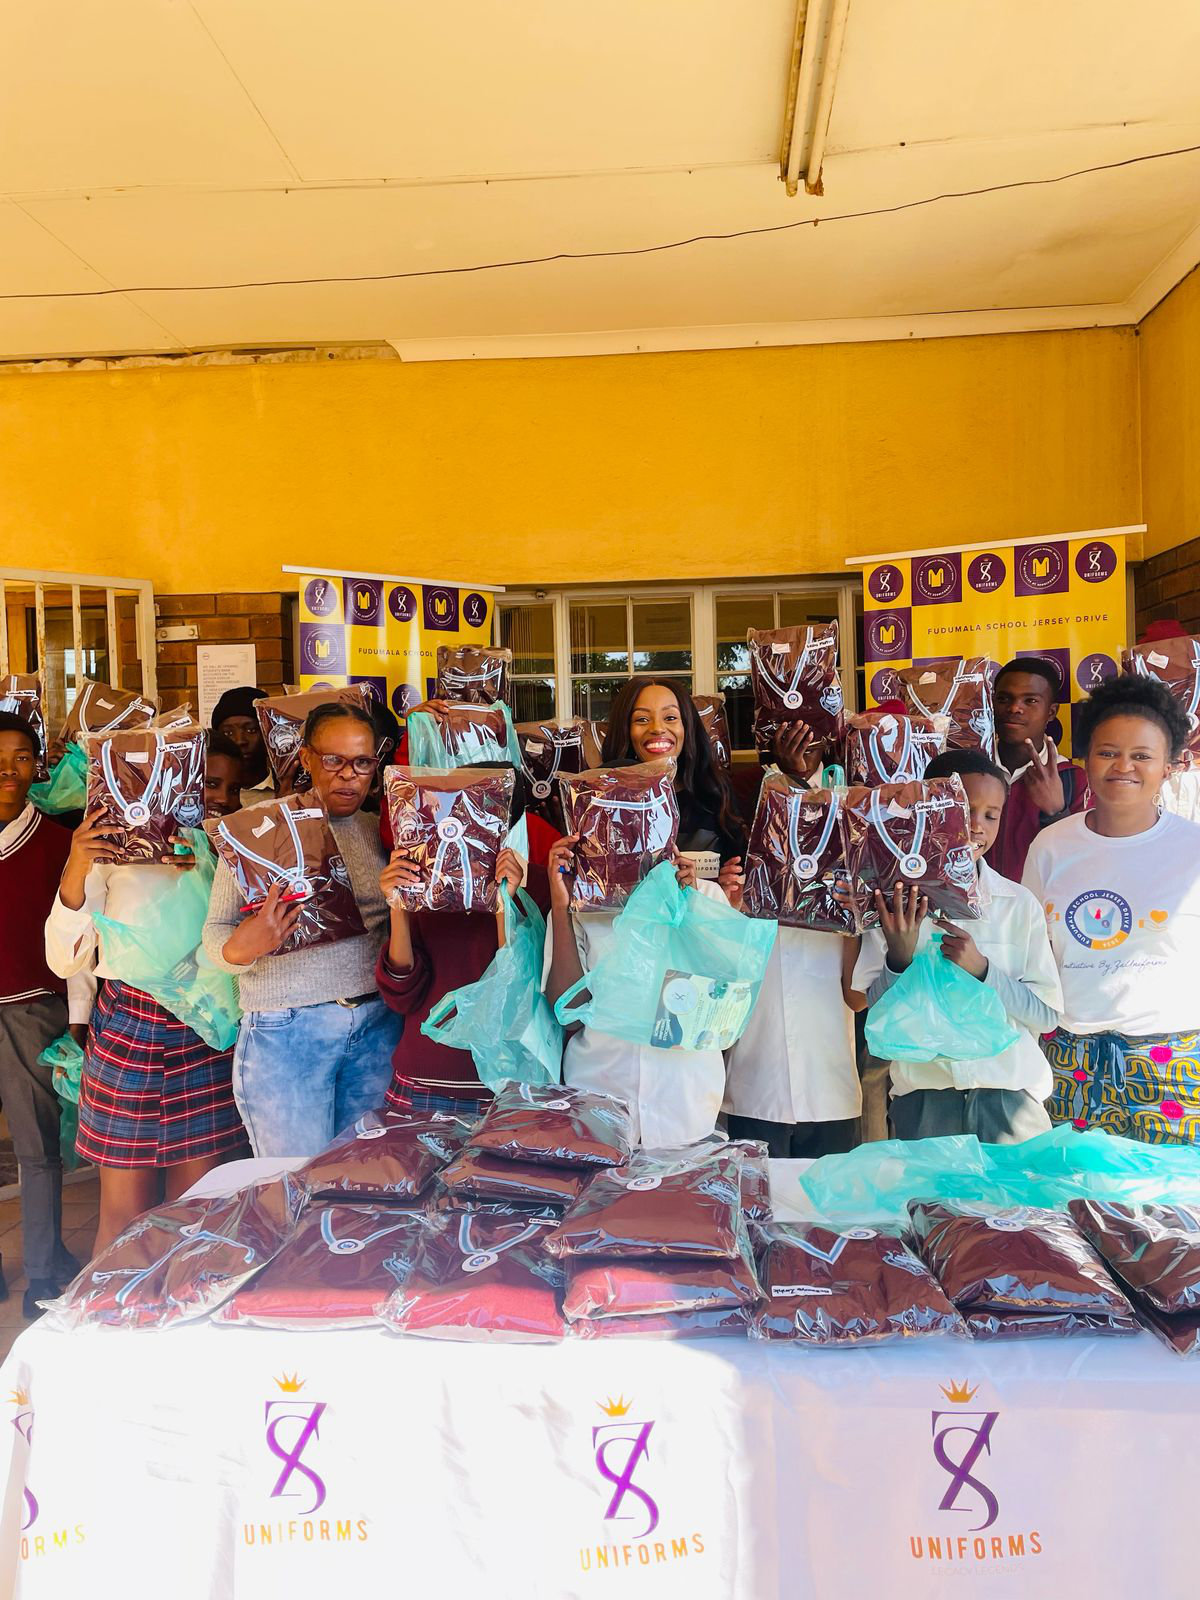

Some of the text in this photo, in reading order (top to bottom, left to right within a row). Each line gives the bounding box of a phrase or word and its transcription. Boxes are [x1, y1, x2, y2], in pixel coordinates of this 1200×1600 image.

[927, 613, 1109, 636] FUDUMALA SCHOOL JERSEY DRIVE
[358, 647, 400, 656] FUDUMALA
[1067, 891, 1130, 945] FUDUMALA SCHOOL JERSEY DRIVE
[1098, 959, 1111, 977] By
[20, 1522, 86, 1561] ORMS
[244, 1518, 369, 1546] UNIFORMS
[909, 1530, 1043, 1561] UNIFORMS
[579, 1532, 705, 1572] UNIFORMS
